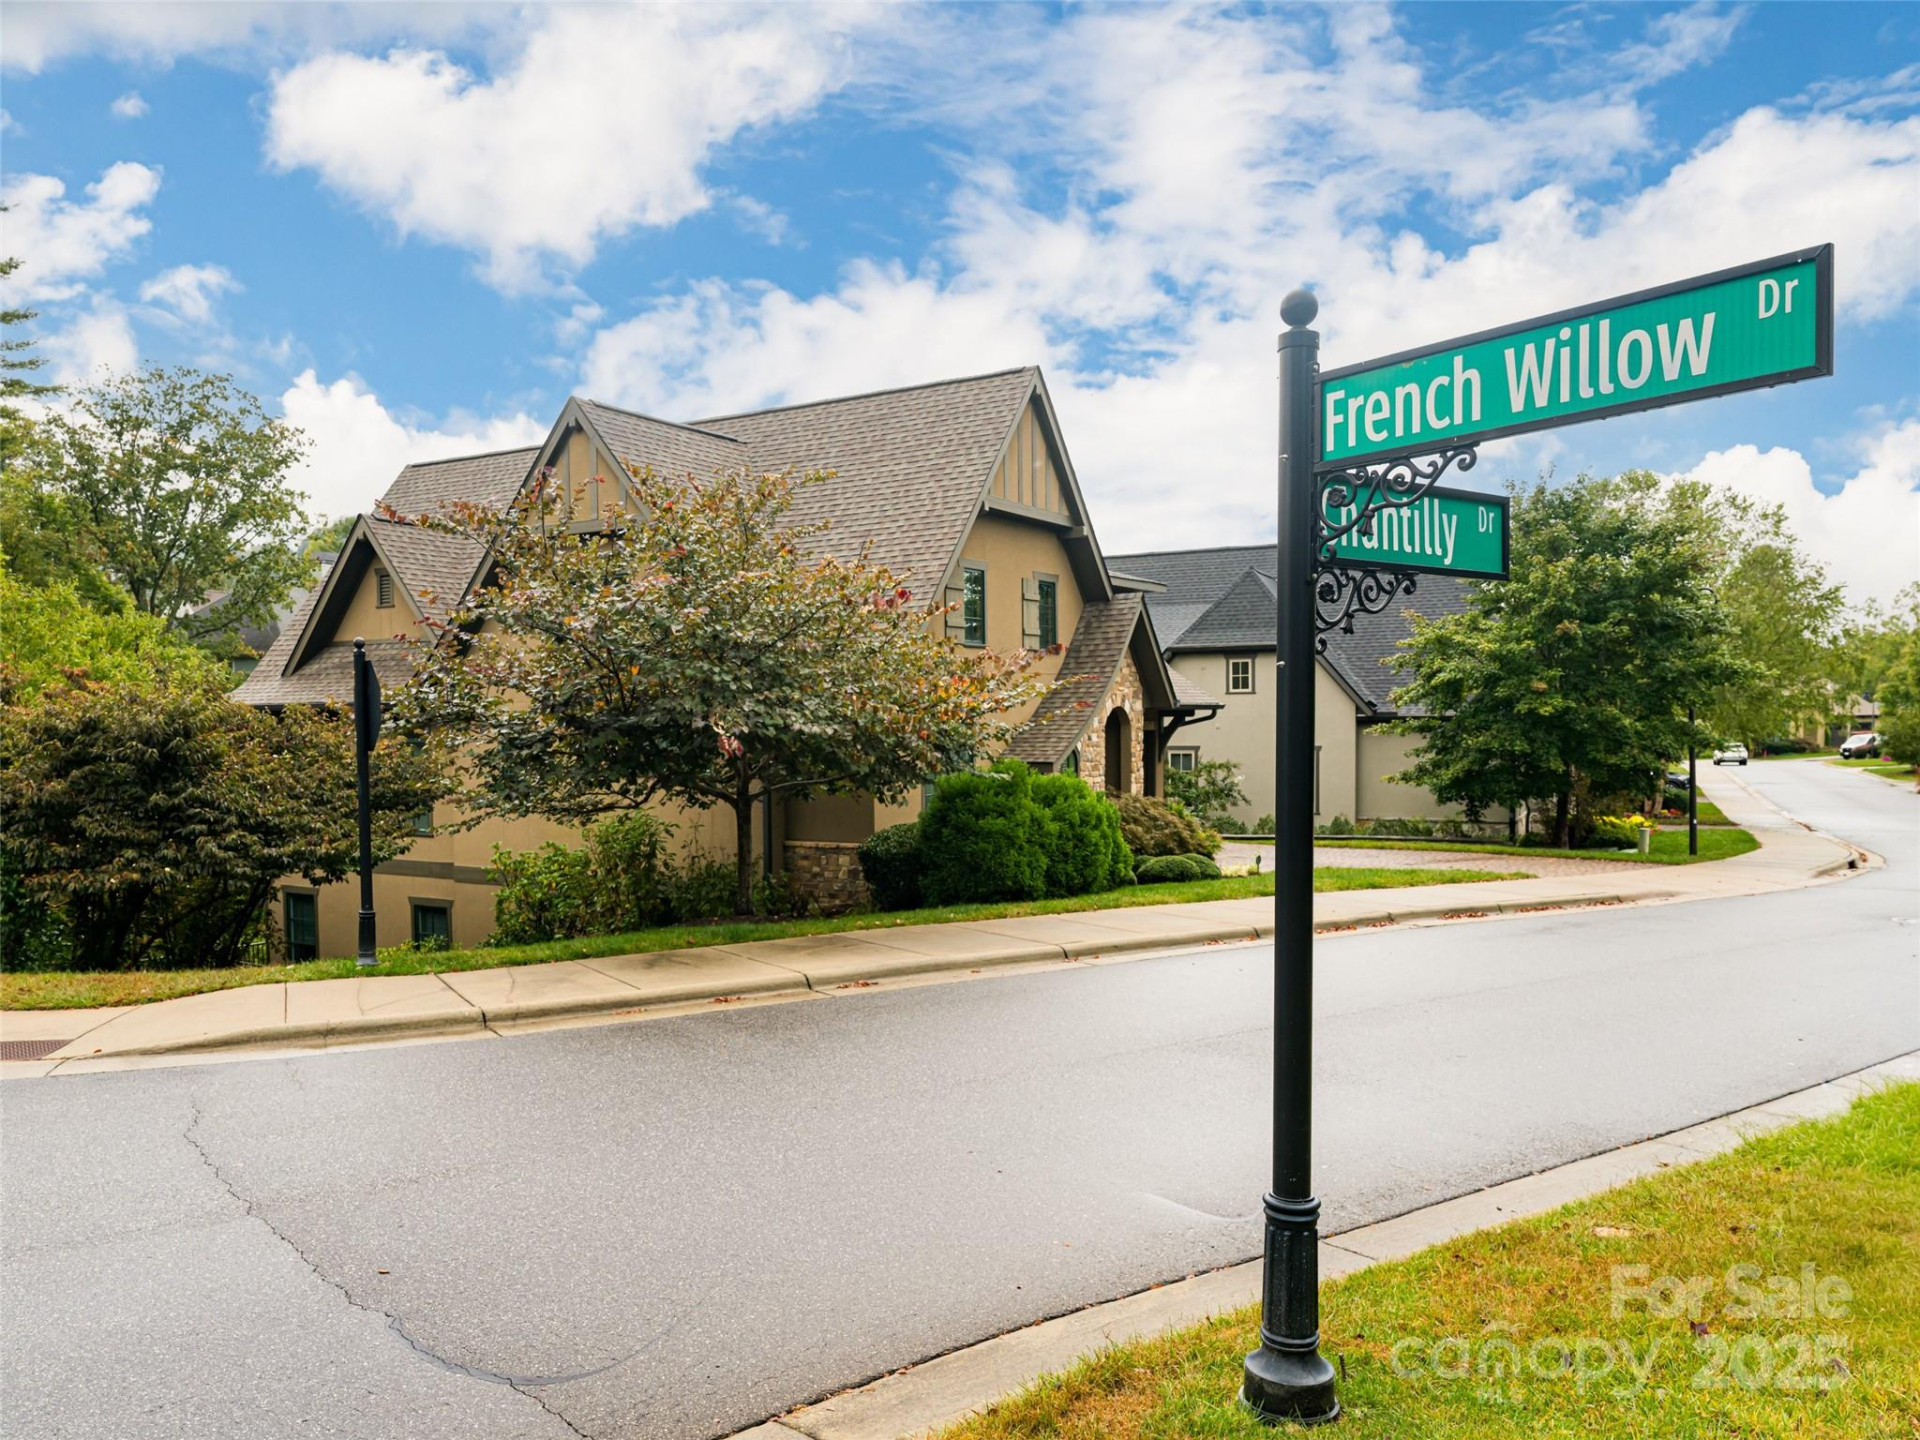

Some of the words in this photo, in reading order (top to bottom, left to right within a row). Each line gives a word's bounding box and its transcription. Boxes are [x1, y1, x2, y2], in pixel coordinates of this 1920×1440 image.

[1325, 355, 1482, 453] French
[1504, 311, 1716, 414] Willow
[1758, 277, 1799, 320] Dr
[1477, 505, 1495, 534] Dr
